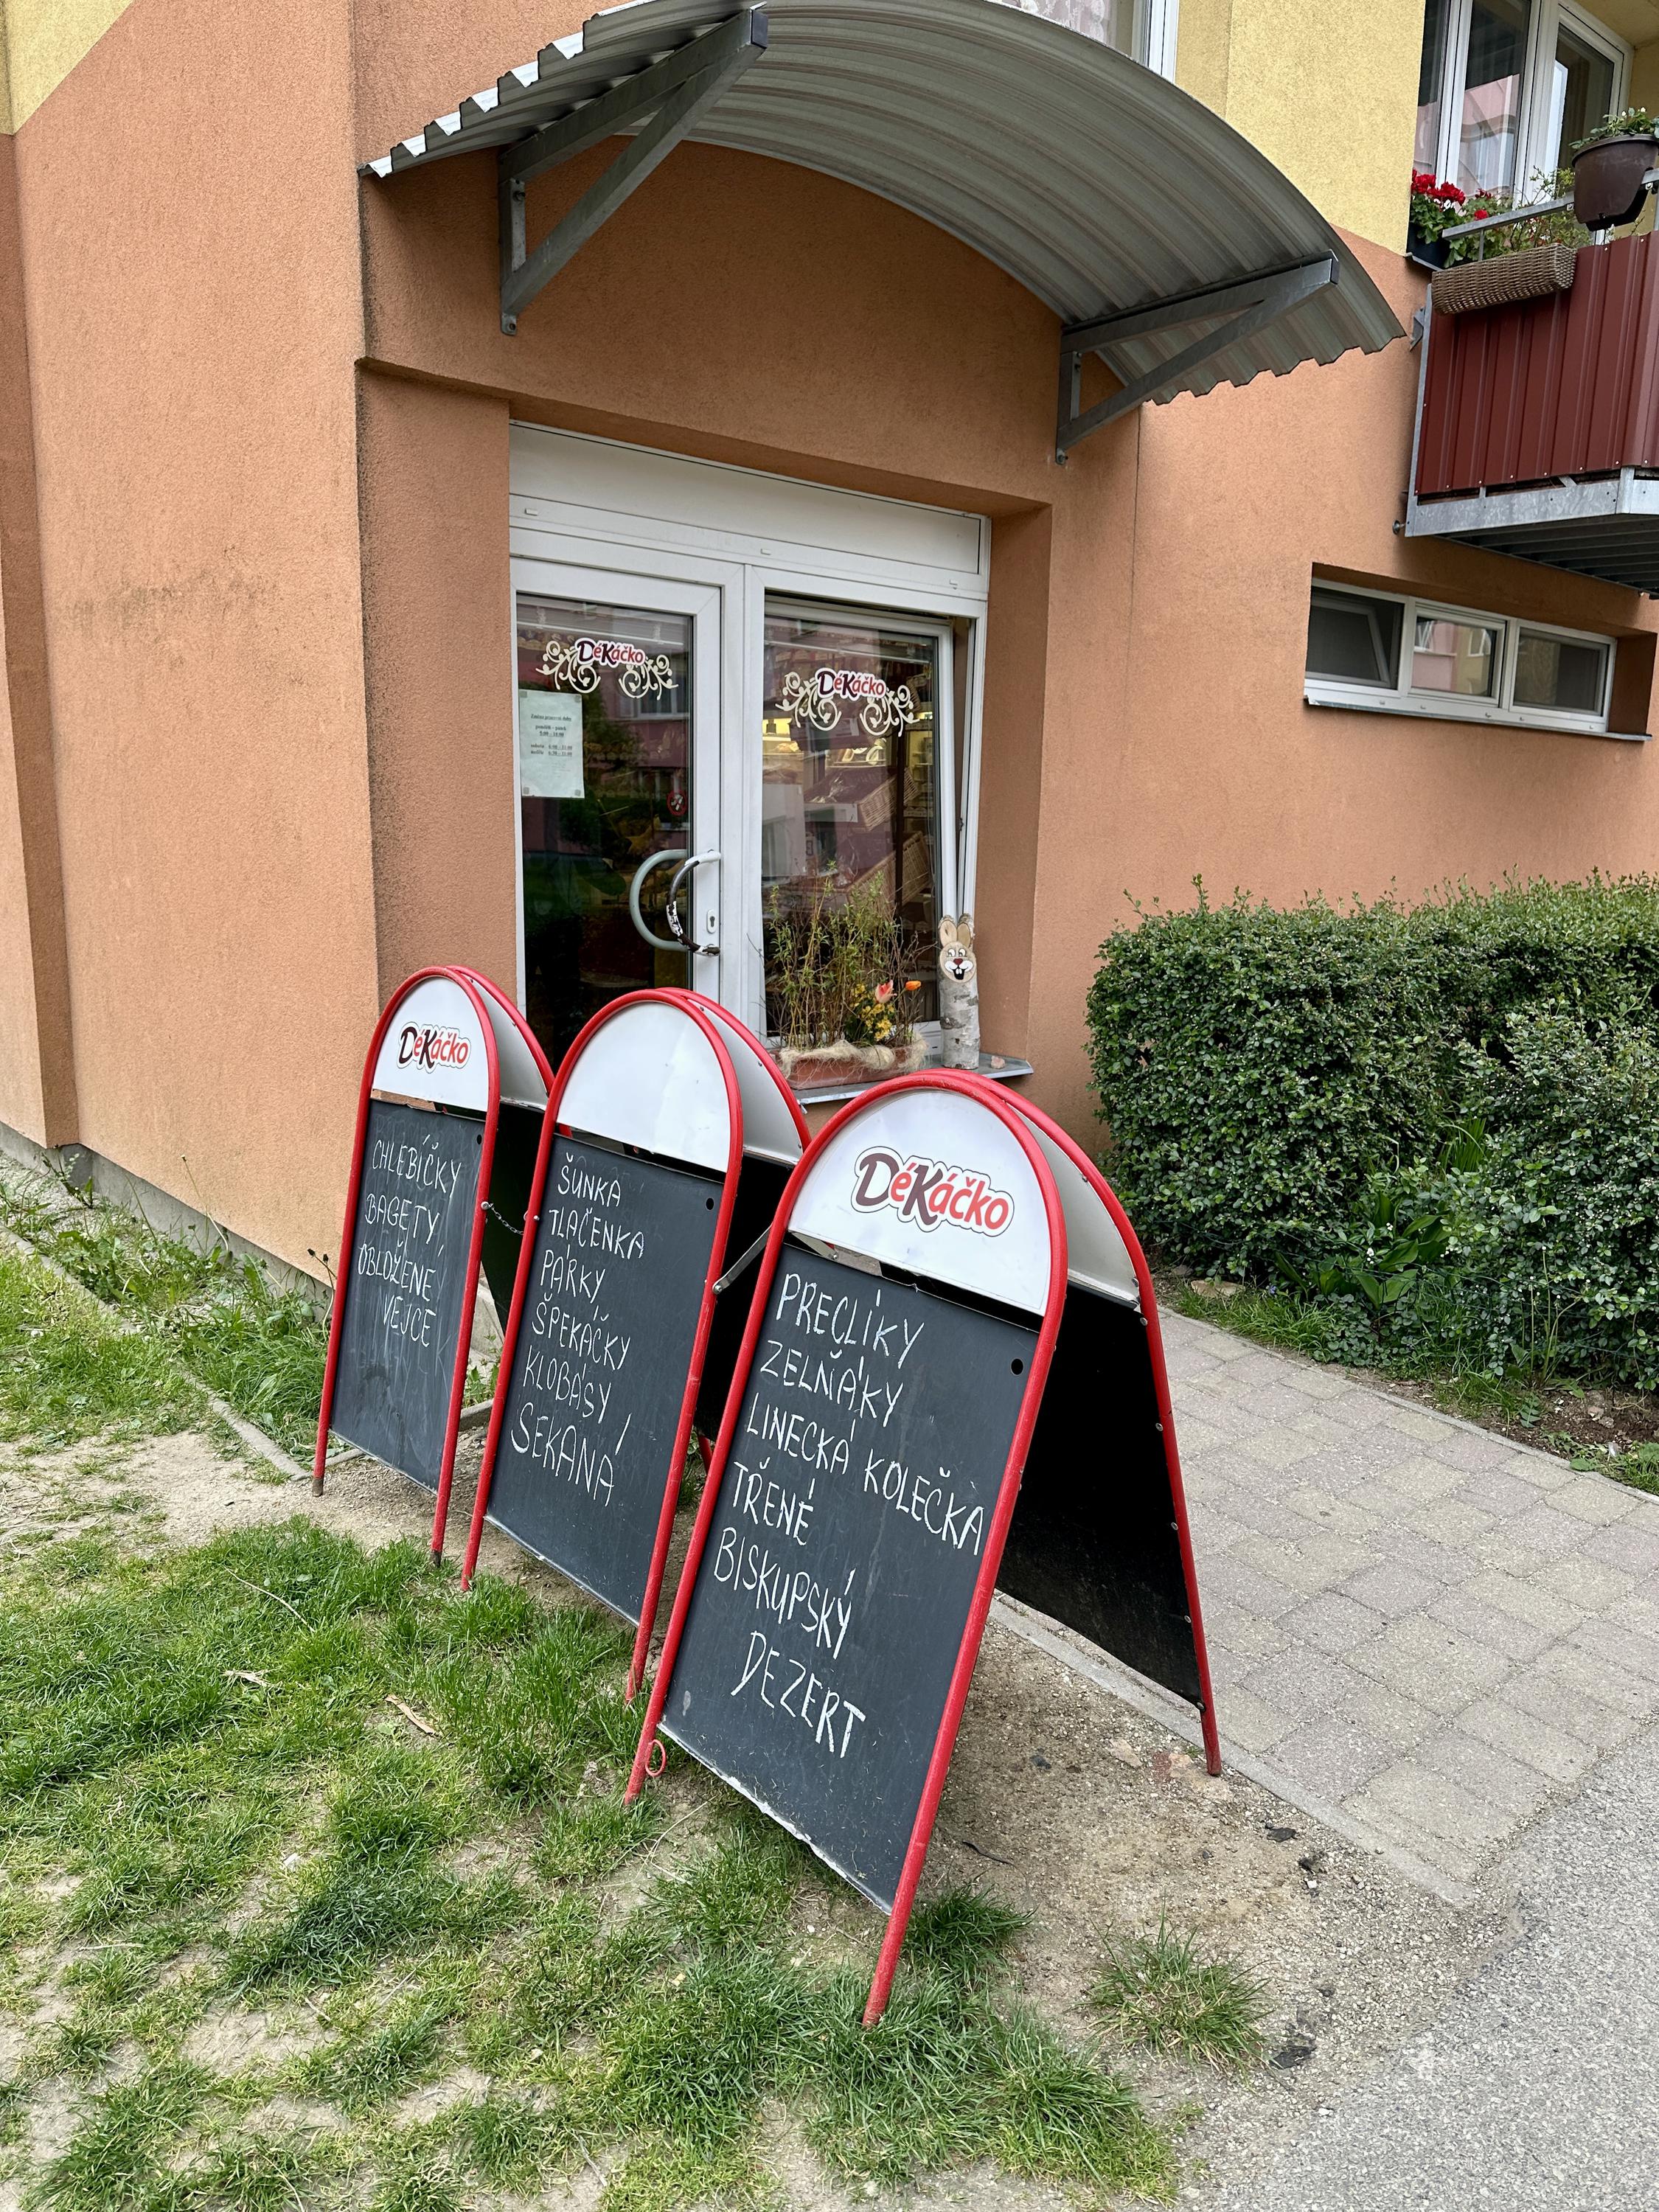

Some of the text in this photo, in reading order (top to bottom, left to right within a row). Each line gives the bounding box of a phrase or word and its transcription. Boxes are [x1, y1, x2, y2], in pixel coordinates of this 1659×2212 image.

[576, 640, 644, 666] DéKáčko
[817, 670, 885, 698] DéKáčko
[398, 1026, 469, 1069] DéKáčko
[372, 1133, 462, 1198] CHLEBÍČKY
[557, 1152, 622, 1208] ŠUNKA
[855, 1152, 1009, 1231] DéKáčko
[364, 1193, 440, 1245] BAGETY
[549, 1206, 645, 1259] TLAČENKA
[358, 1240, 444, 1302] OBLOŽENÉ
[540, 1244, 606, 1304] PÁRKY
[383, 1294, 437, 1348] VEJCE
[532, 1292, 631, 1371] ŠPEKÁČKY
[776, 1273, 925, 1369] PRECLÍKY
[523, 1344, 612, 1425] KLOBÁSY
[759, 1340, 904, 1427] ZELŇÁKY
[510, 1402, 633, 1507] SEKANÁ
[746, 1391, 985, 1556] LINECKÁ KOLEČKA
[733, 1456, 815, 1545] TŘENÉ
[713, 1526, 857, 1660] BISKUPSKÝ
[730, 1630, 866, 1759] DEZERT
